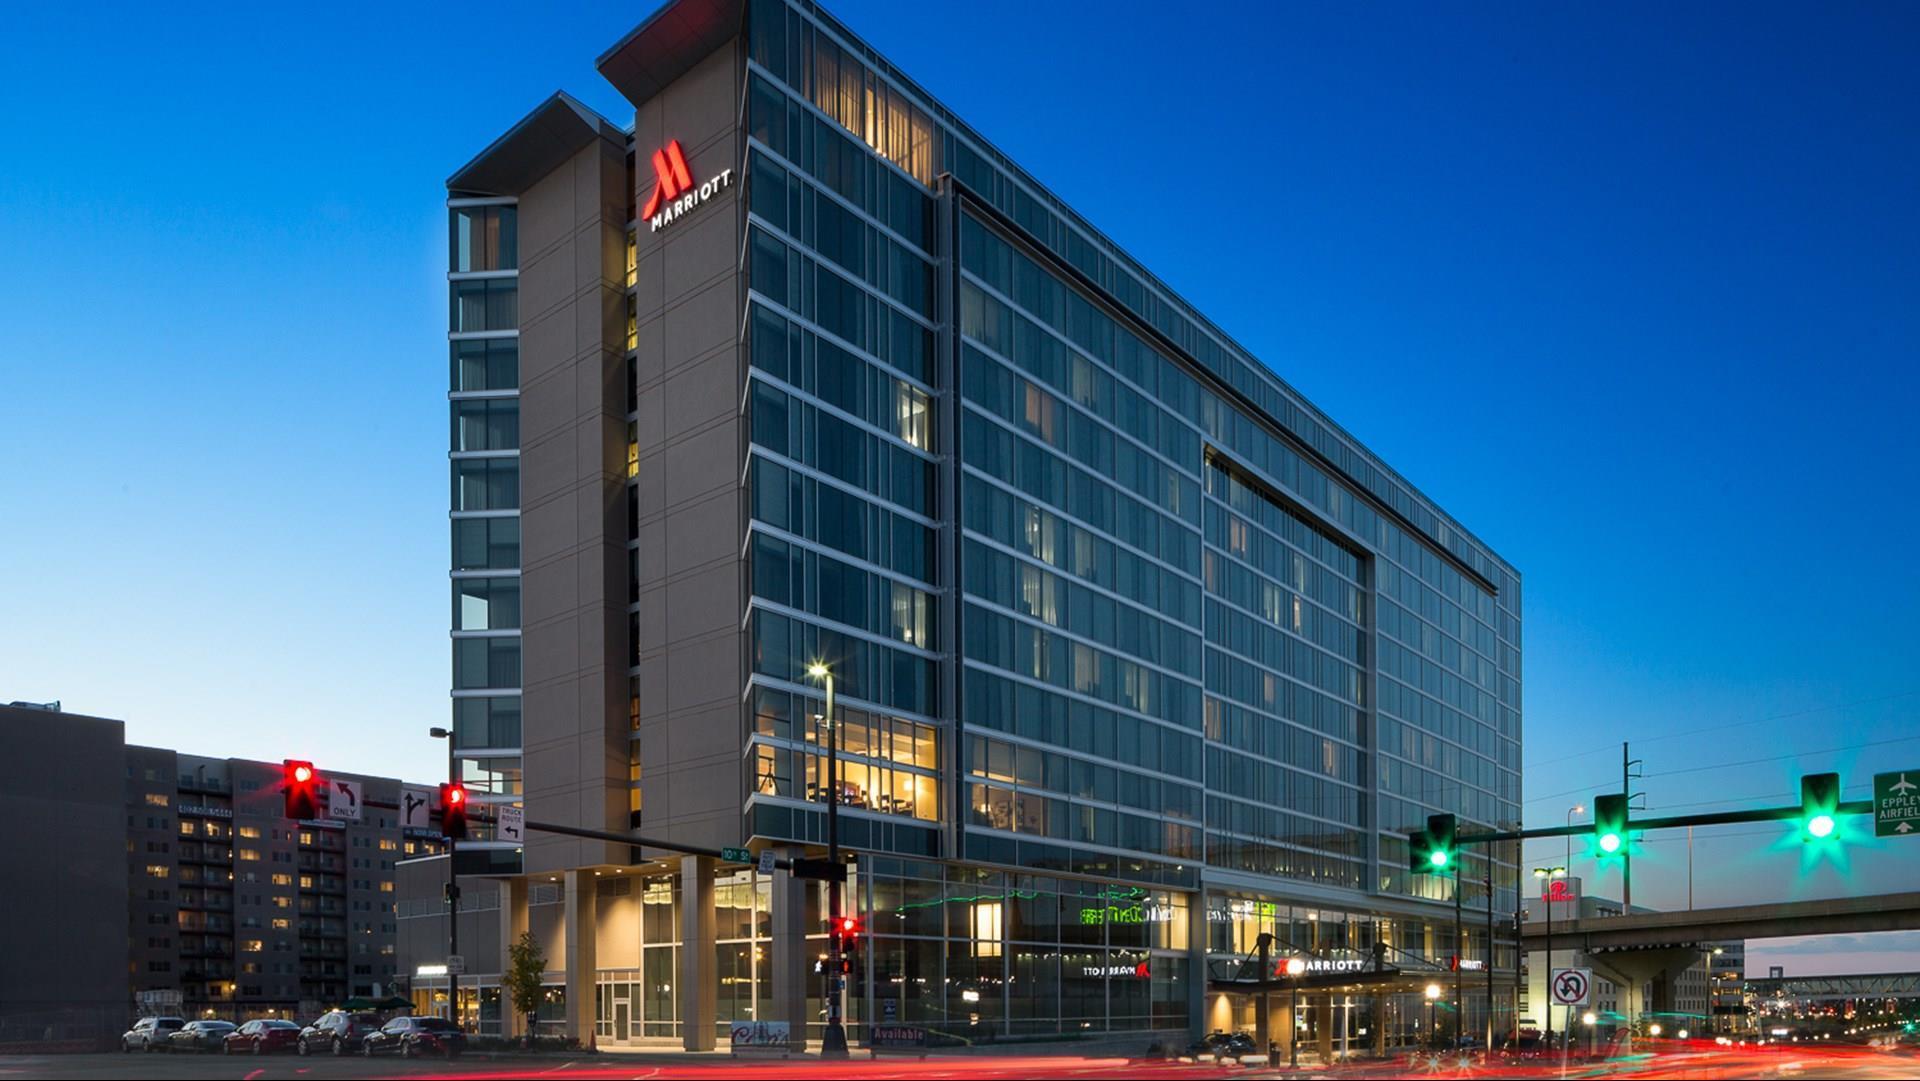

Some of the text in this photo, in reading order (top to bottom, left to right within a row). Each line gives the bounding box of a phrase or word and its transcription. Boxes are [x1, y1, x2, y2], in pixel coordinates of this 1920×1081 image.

[651, 168, 731, 232] MARRIOTT
[333, 806, 356, 817] ONLY
[502, 807, 521, 815] TRUCK
[502, 815, 521, 824] ROUTE
[1297, 960, 1363, 971] ARRIOTT
[874, 1027, 924, 1040] Available
